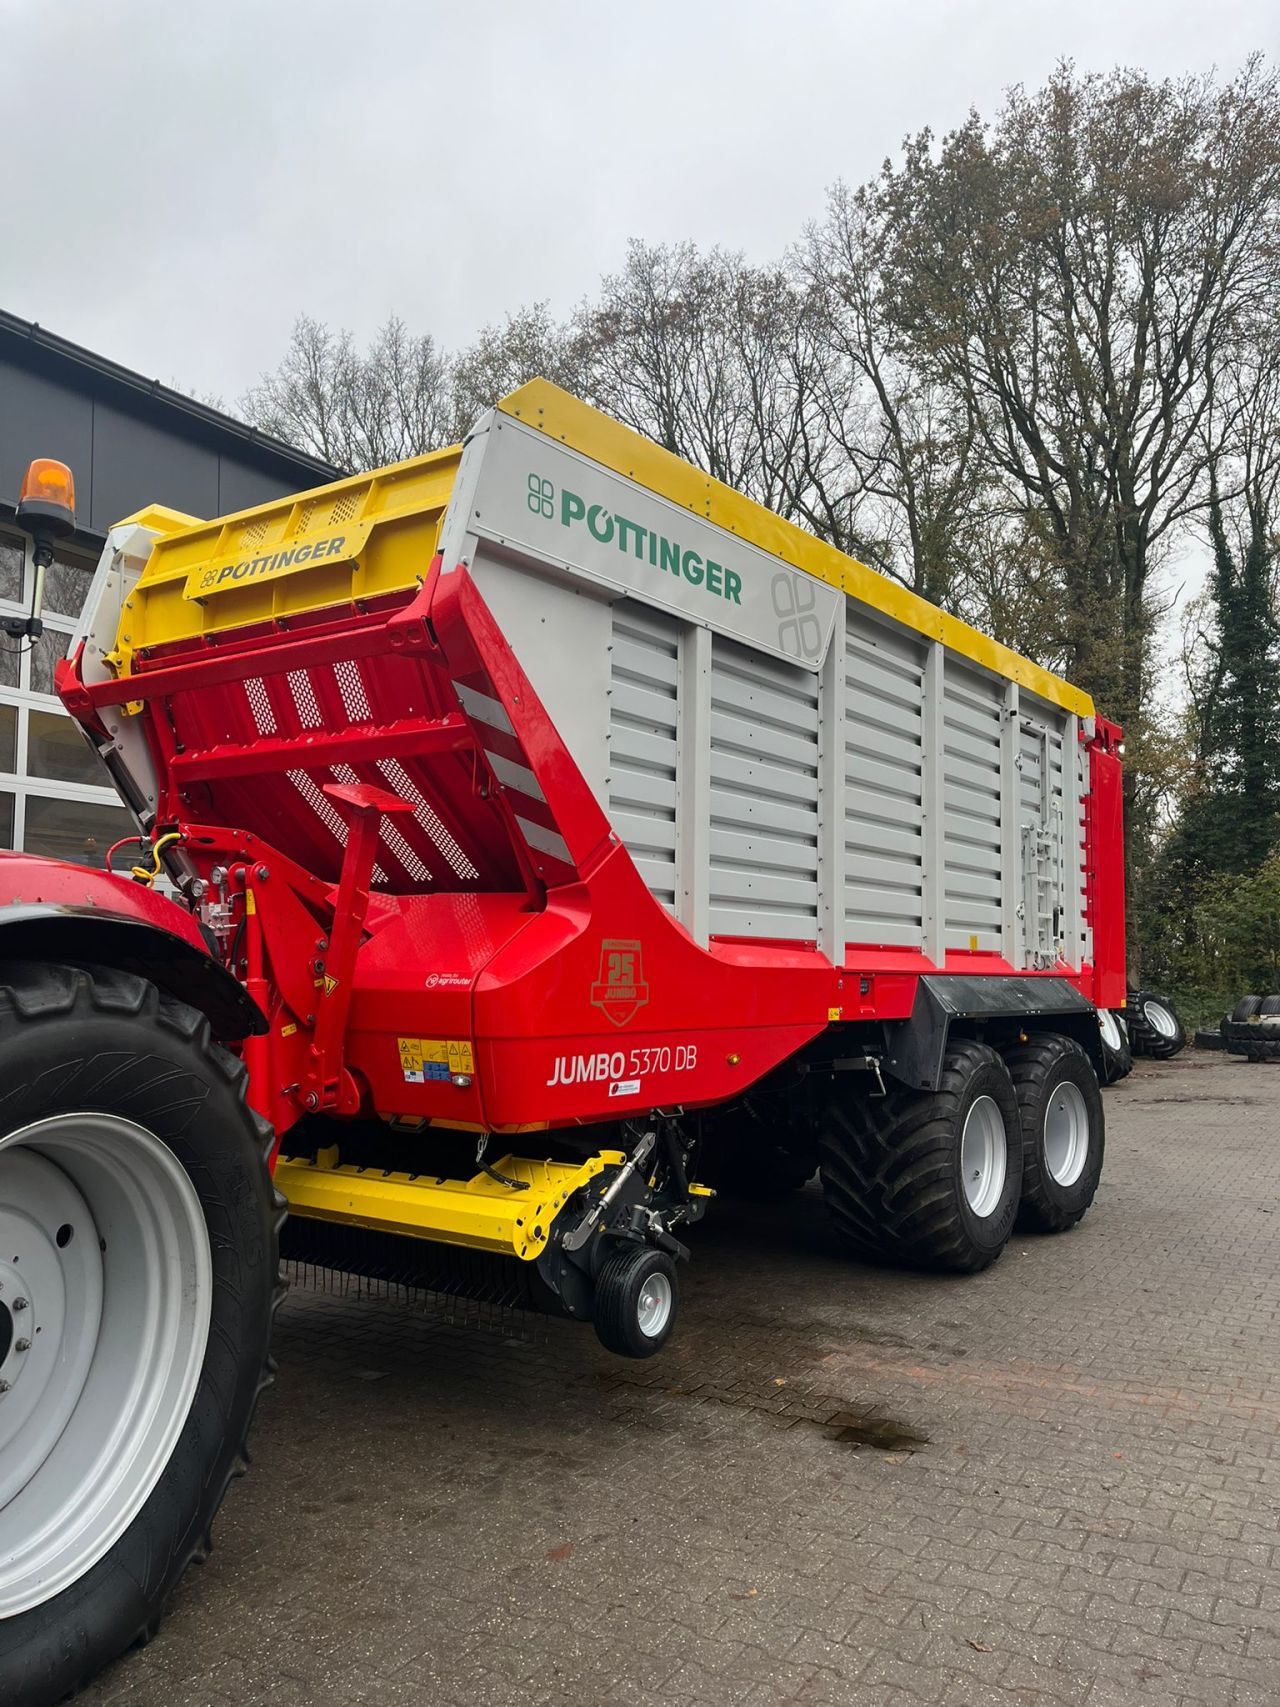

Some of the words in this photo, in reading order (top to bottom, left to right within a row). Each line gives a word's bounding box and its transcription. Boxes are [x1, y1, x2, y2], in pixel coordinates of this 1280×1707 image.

[216, 536, 346, 584] PÖTTINGER
[561, 488, 742, 606] PÖTTINGER
[608, 953, 635, 985] 25
[605, 986, 637, 999] JUMBO
[546, 1051, 625, 1087] JUMBO
[629, 1046, 671, 1076] 5370
[675, 1045, 698, 1071] DB
